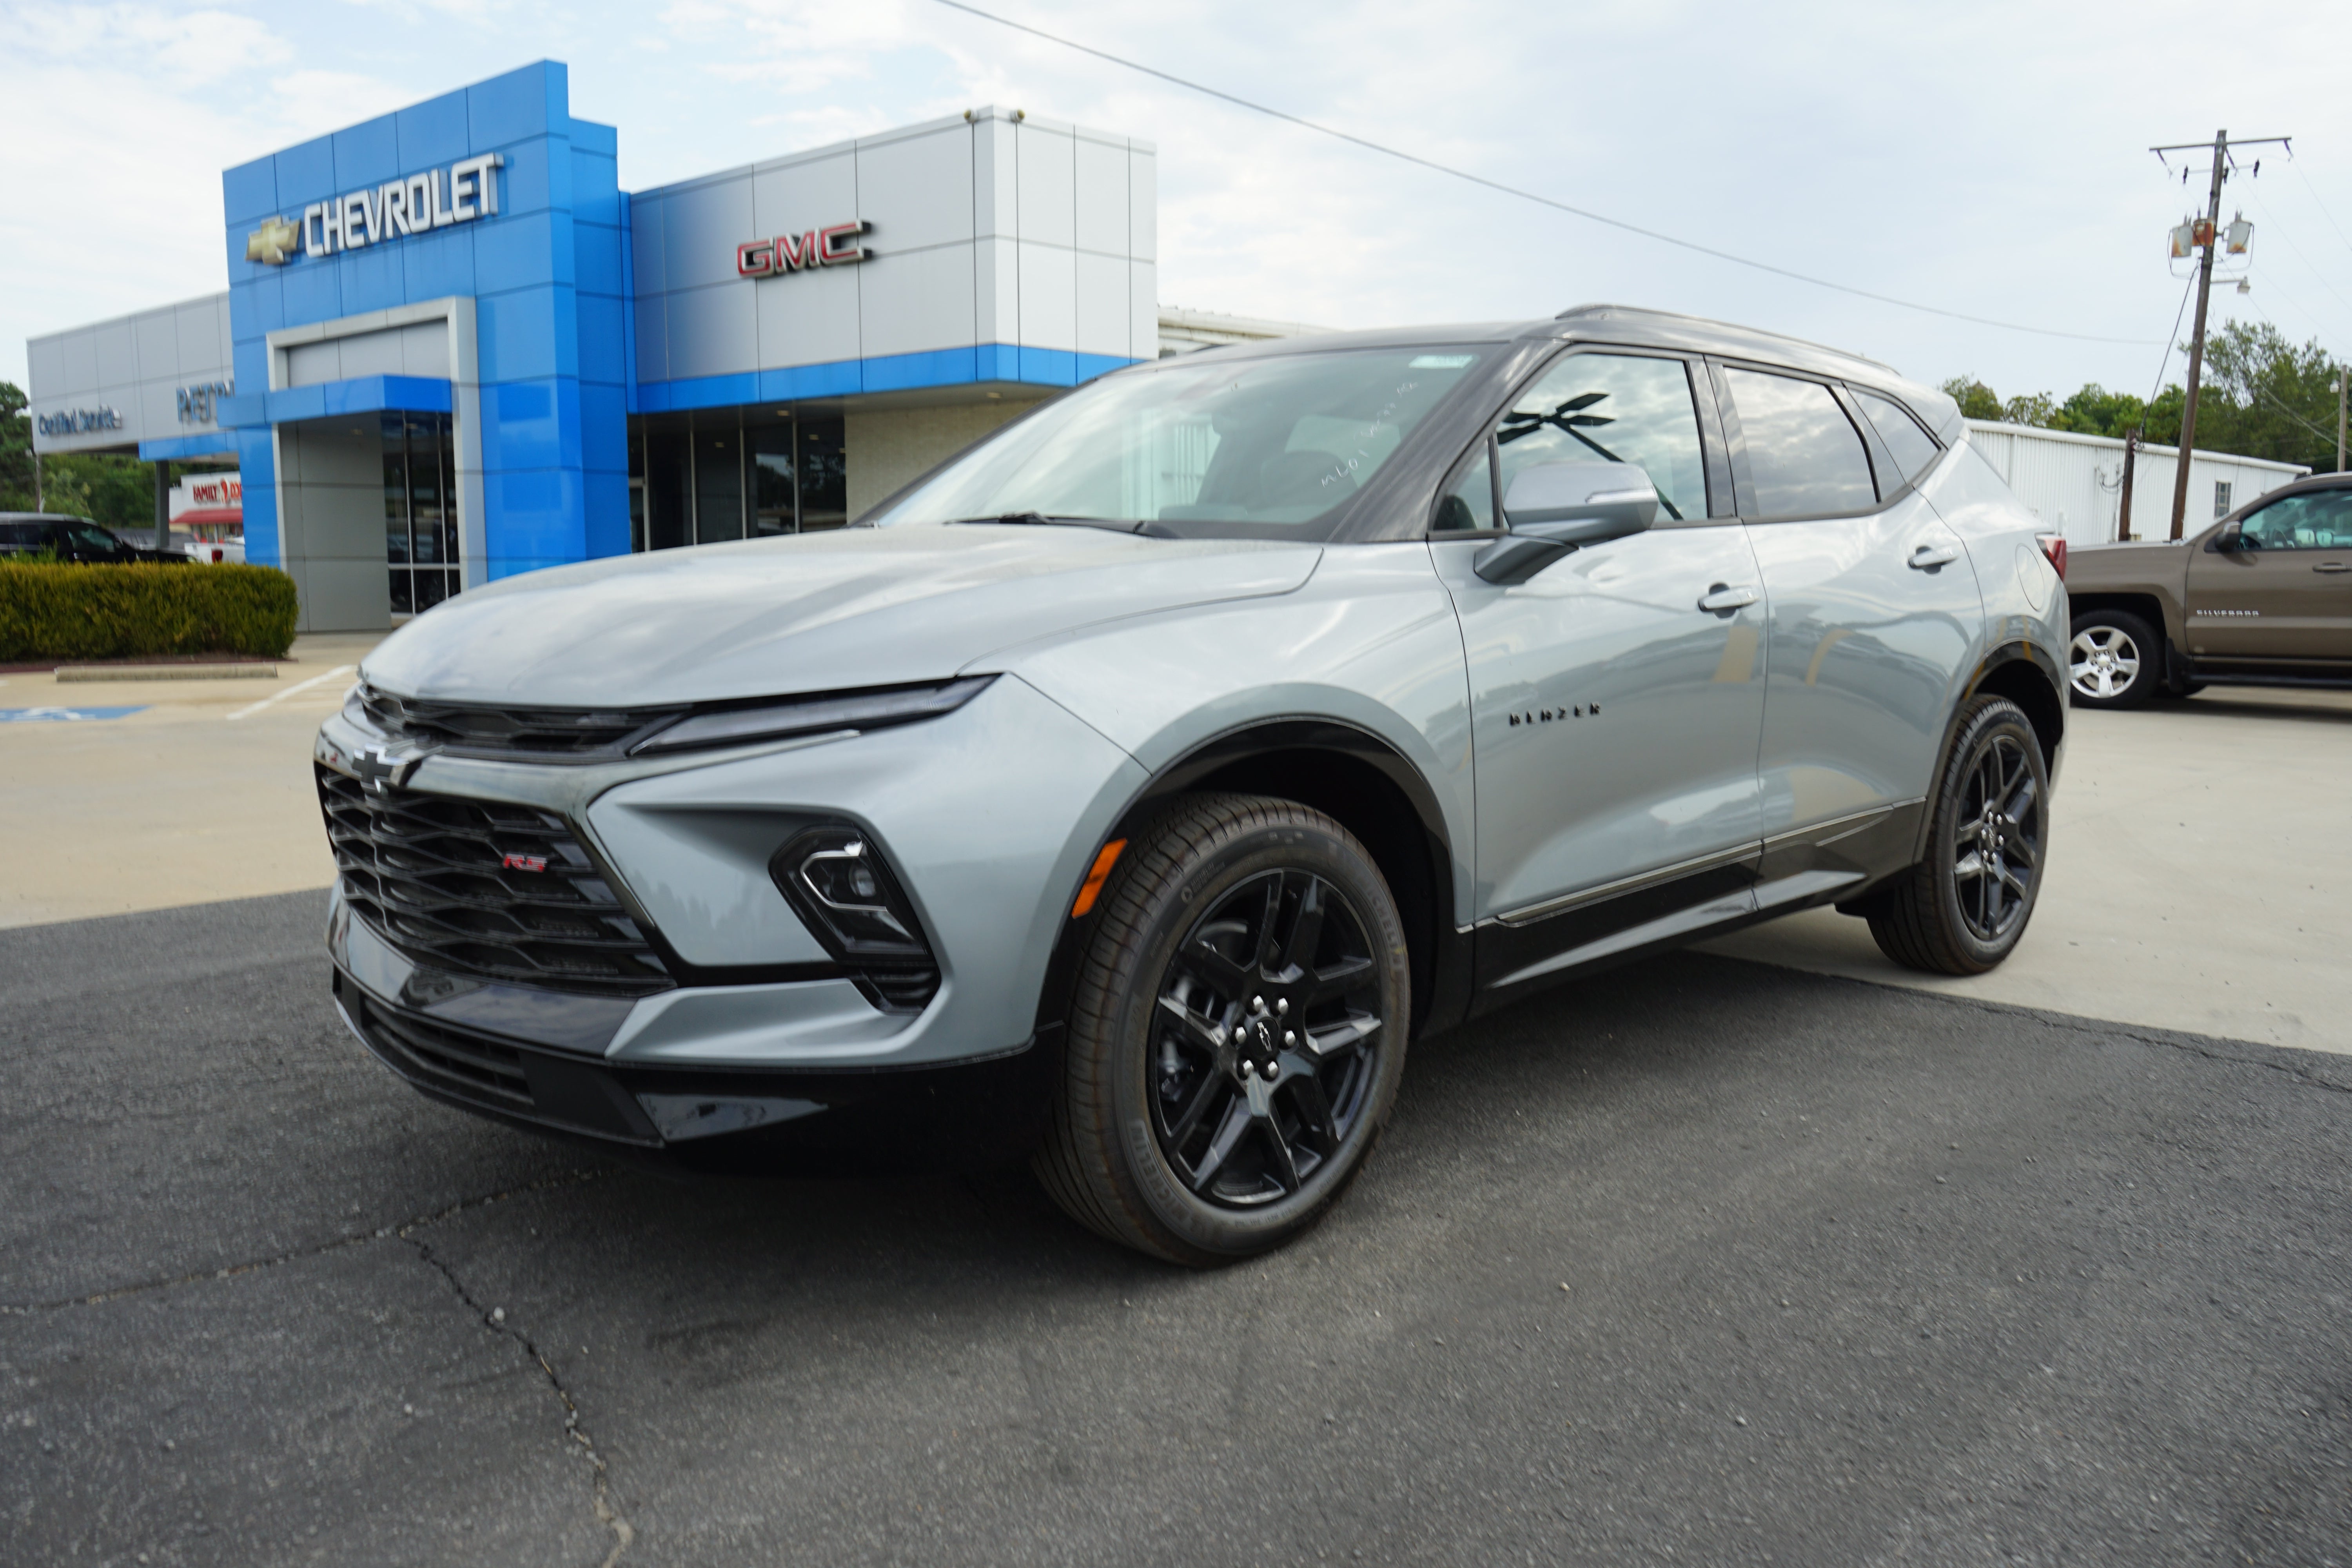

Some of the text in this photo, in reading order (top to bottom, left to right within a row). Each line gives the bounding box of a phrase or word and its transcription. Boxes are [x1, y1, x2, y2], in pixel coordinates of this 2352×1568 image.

[304, 152, 505, 258] CHEVROLET
[737, 218, 867, 277] GMC
[192, 485, 218, 501] FAMILY
[2196, 609, 2259, 618] SILVERADO
[1509, 702, 1601, 726] BLAZER
[503, 853, 548, 873] RS
